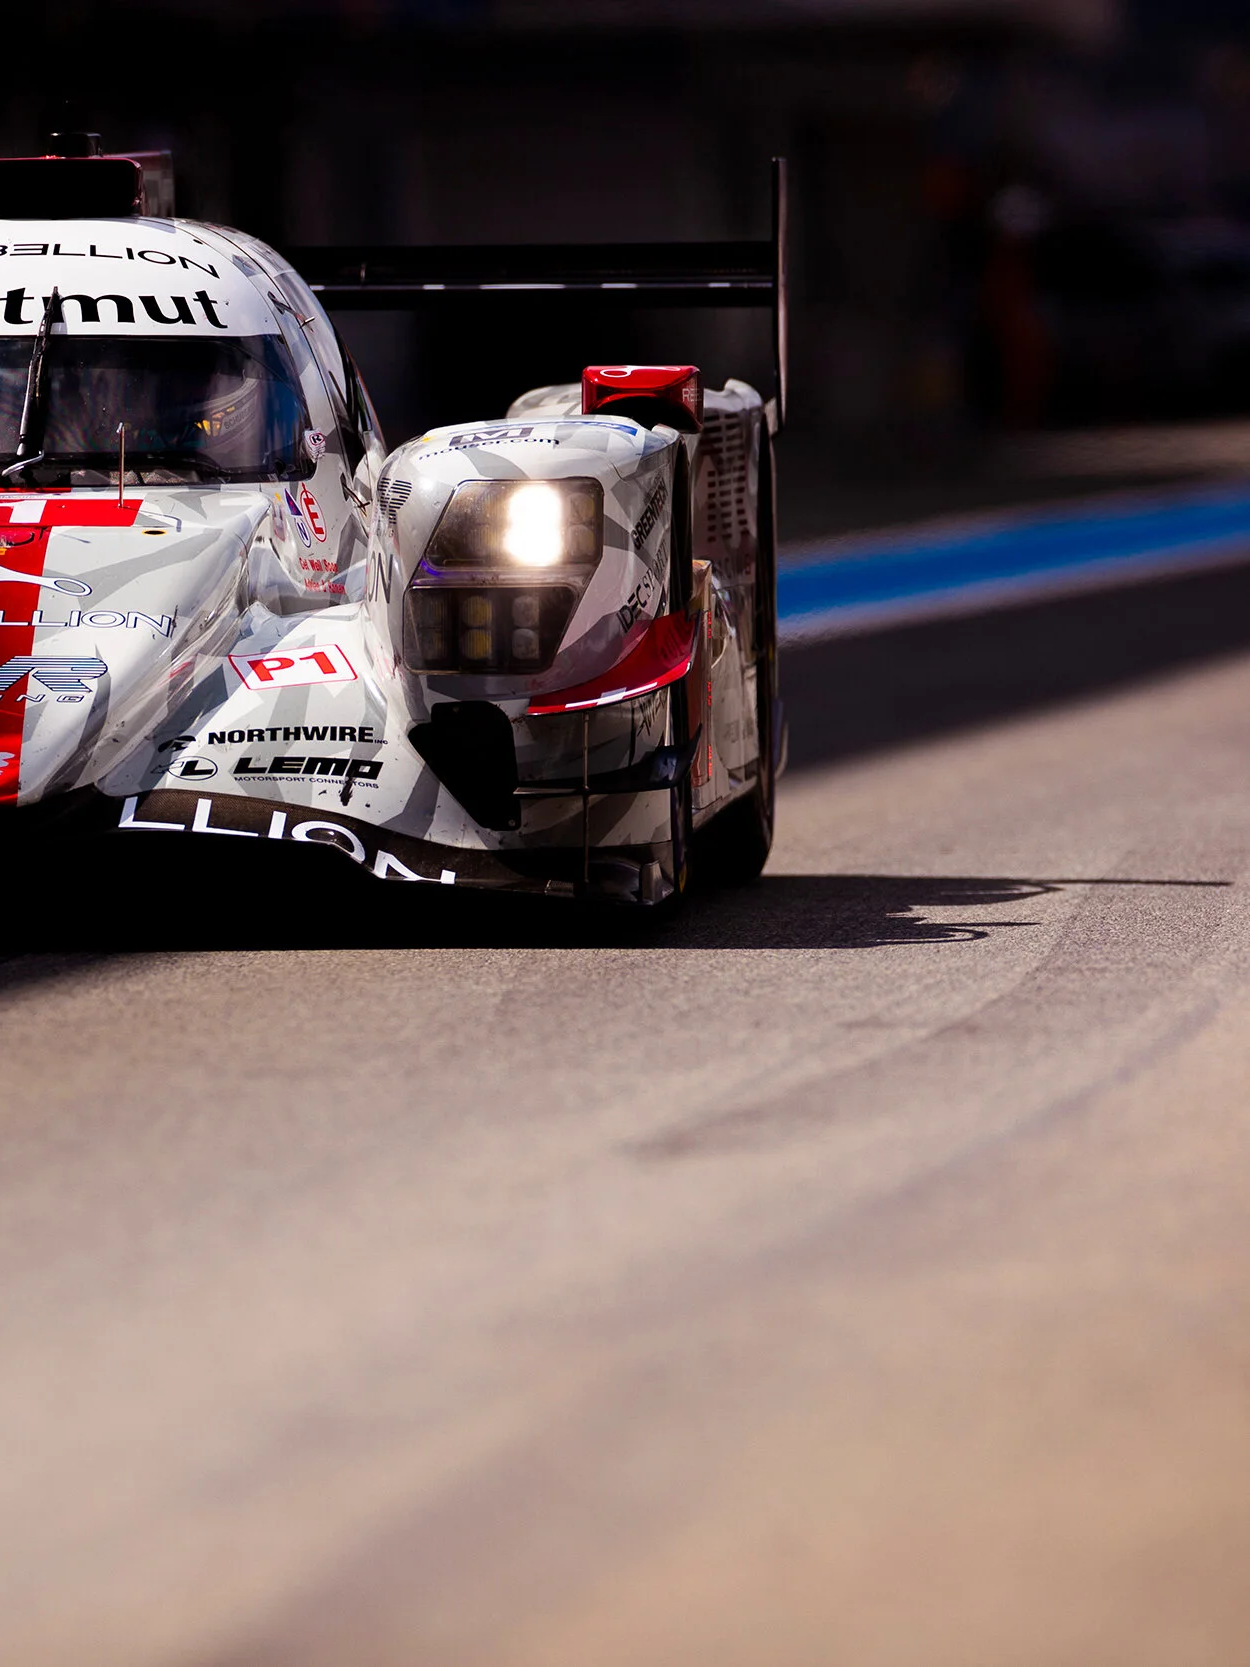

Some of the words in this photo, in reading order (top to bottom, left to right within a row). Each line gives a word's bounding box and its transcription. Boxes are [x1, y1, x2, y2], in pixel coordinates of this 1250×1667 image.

[419, 438, 560, 460] mouser.com
[247, 651, 337, 682] P1
[208, 726, 374, 745] NORTHWIRE
[233, 757, 384, 780] LEMO
[308, 777, 380, 789] CONNETORS
